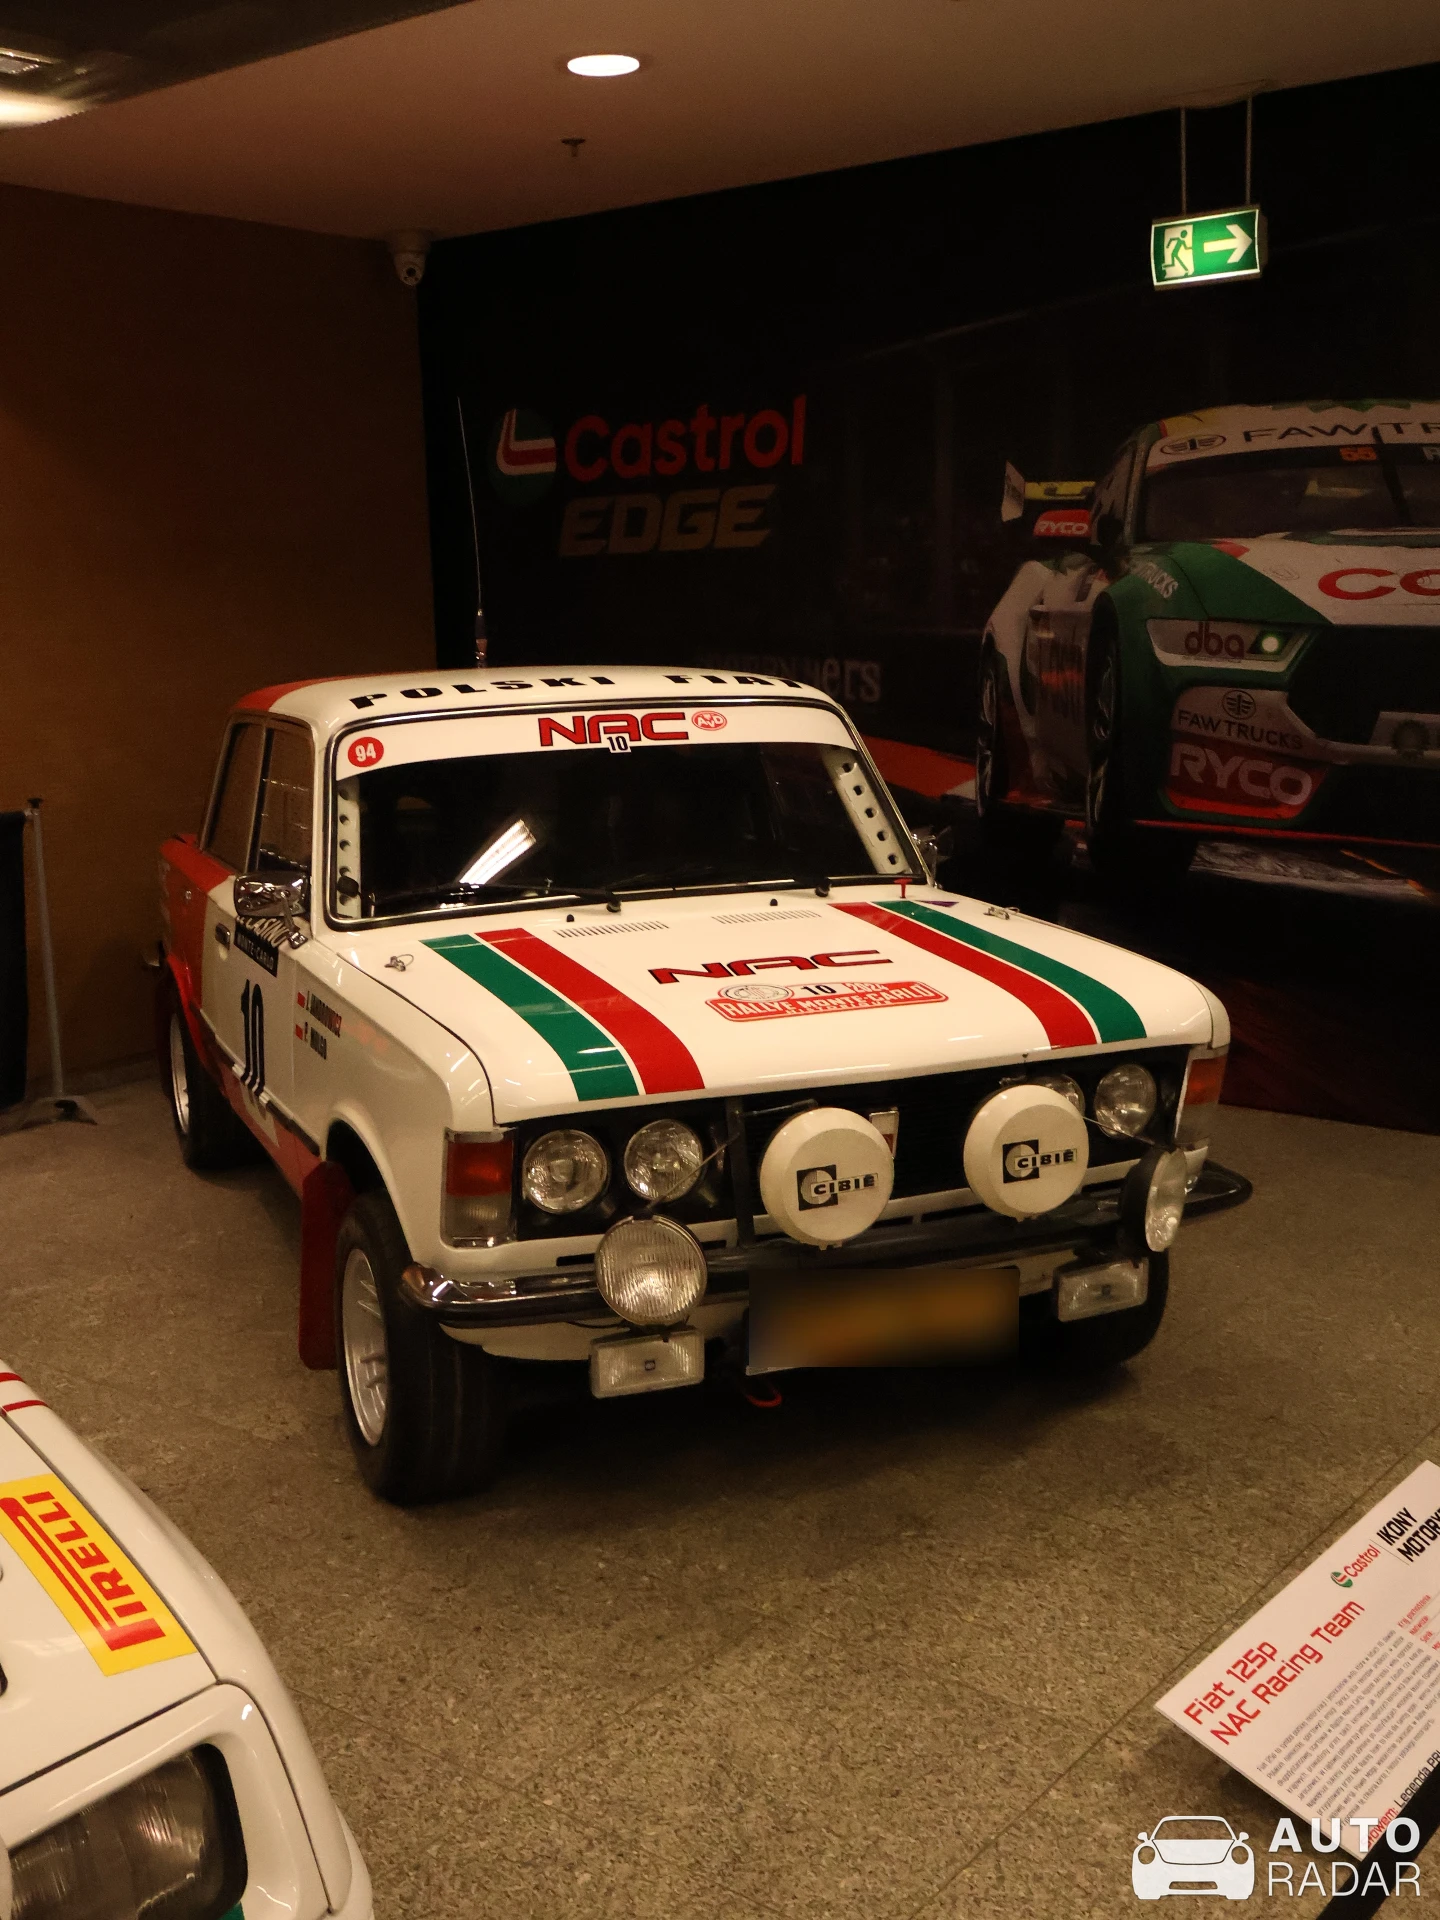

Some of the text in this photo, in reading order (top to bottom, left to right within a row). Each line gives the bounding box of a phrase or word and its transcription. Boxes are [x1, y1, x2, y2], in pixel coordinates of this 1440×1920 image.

[565, 394, 807, 482] Castrol
[559, 484, 777, 557] EDGE
[1038, 520, 1089, 535] RYCO
[1184, 621, 1245, 659] dba
[349, 674, 804, 709] POLSKI FIAT
[537, 711, 690, 748] NAC
[606, 735, 629, 752] 10
[1177, 709, 1304, 751] FAW TRUCKS
[355, 744, 377, 761] 94
[1171, 746, 1314, 806] RYCO
[648, 949, 894, 984] NAC
[721, 1001, 796, 1018] RALLYE
[800, 984, 837, 997] 10
[240, 978, 265, 1096] 10
[1377, 1506, 1418, 1546] IKONY
[1396, 1506, 1440, 1563] MOTORY
[0, 1490, 166, 1653] PIRELLI
[1343, 1544, 1381, 1578] Castrol
[1183, 1640, 1278, 1726] Fiat 125p
[1210, 1699, 1261, 1746] NAC
[1257, 1640, 1324, 1703] Racing
[1310, 1600, 1366, 1643] Team
[1393, 1766, 1431, 1808] Legenda
